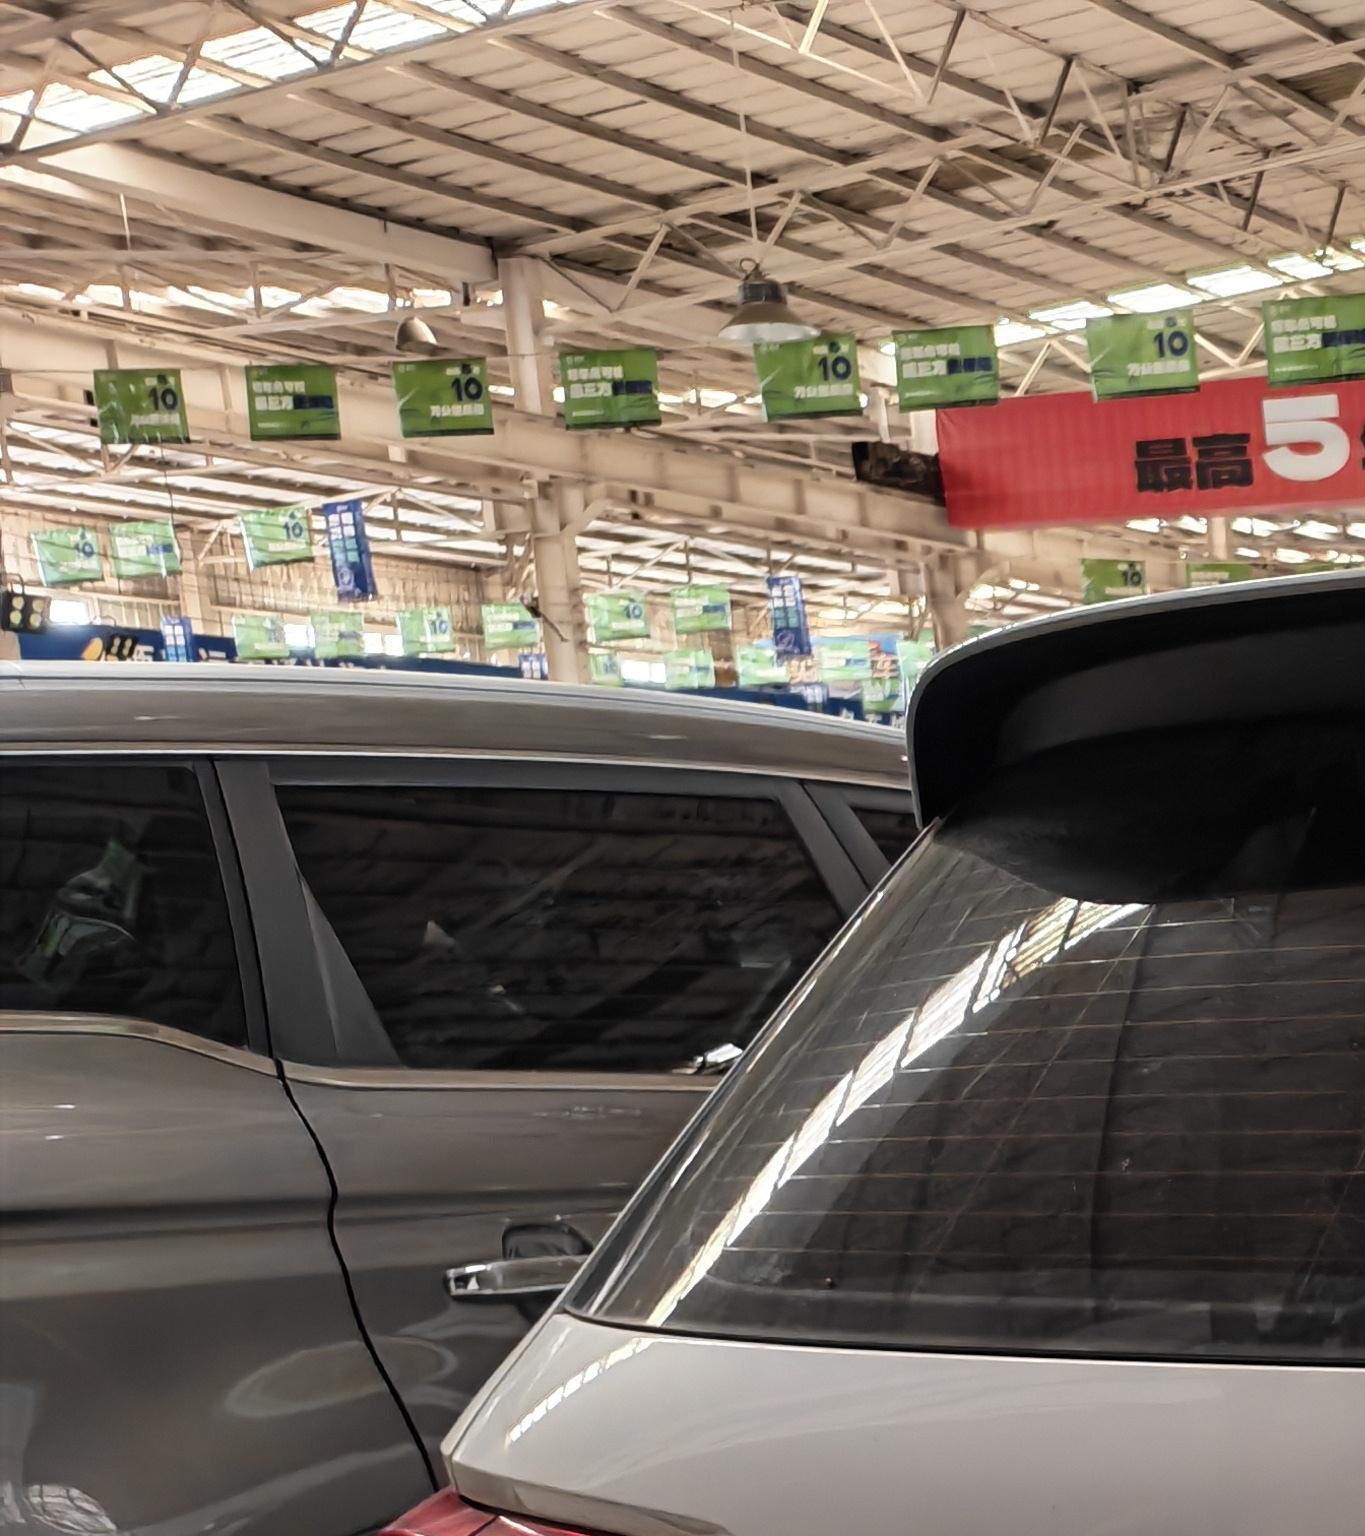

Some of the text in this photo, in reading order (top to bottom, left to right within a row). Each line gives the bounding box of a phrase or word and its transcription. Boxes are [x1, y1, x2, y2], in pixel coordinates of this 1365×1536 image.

[1154, 331, 1188, 358] 10
[818, 356, 851, 381] 10
[149, 387, 178, 411] 10
[451, 377, 484, 401] 10
